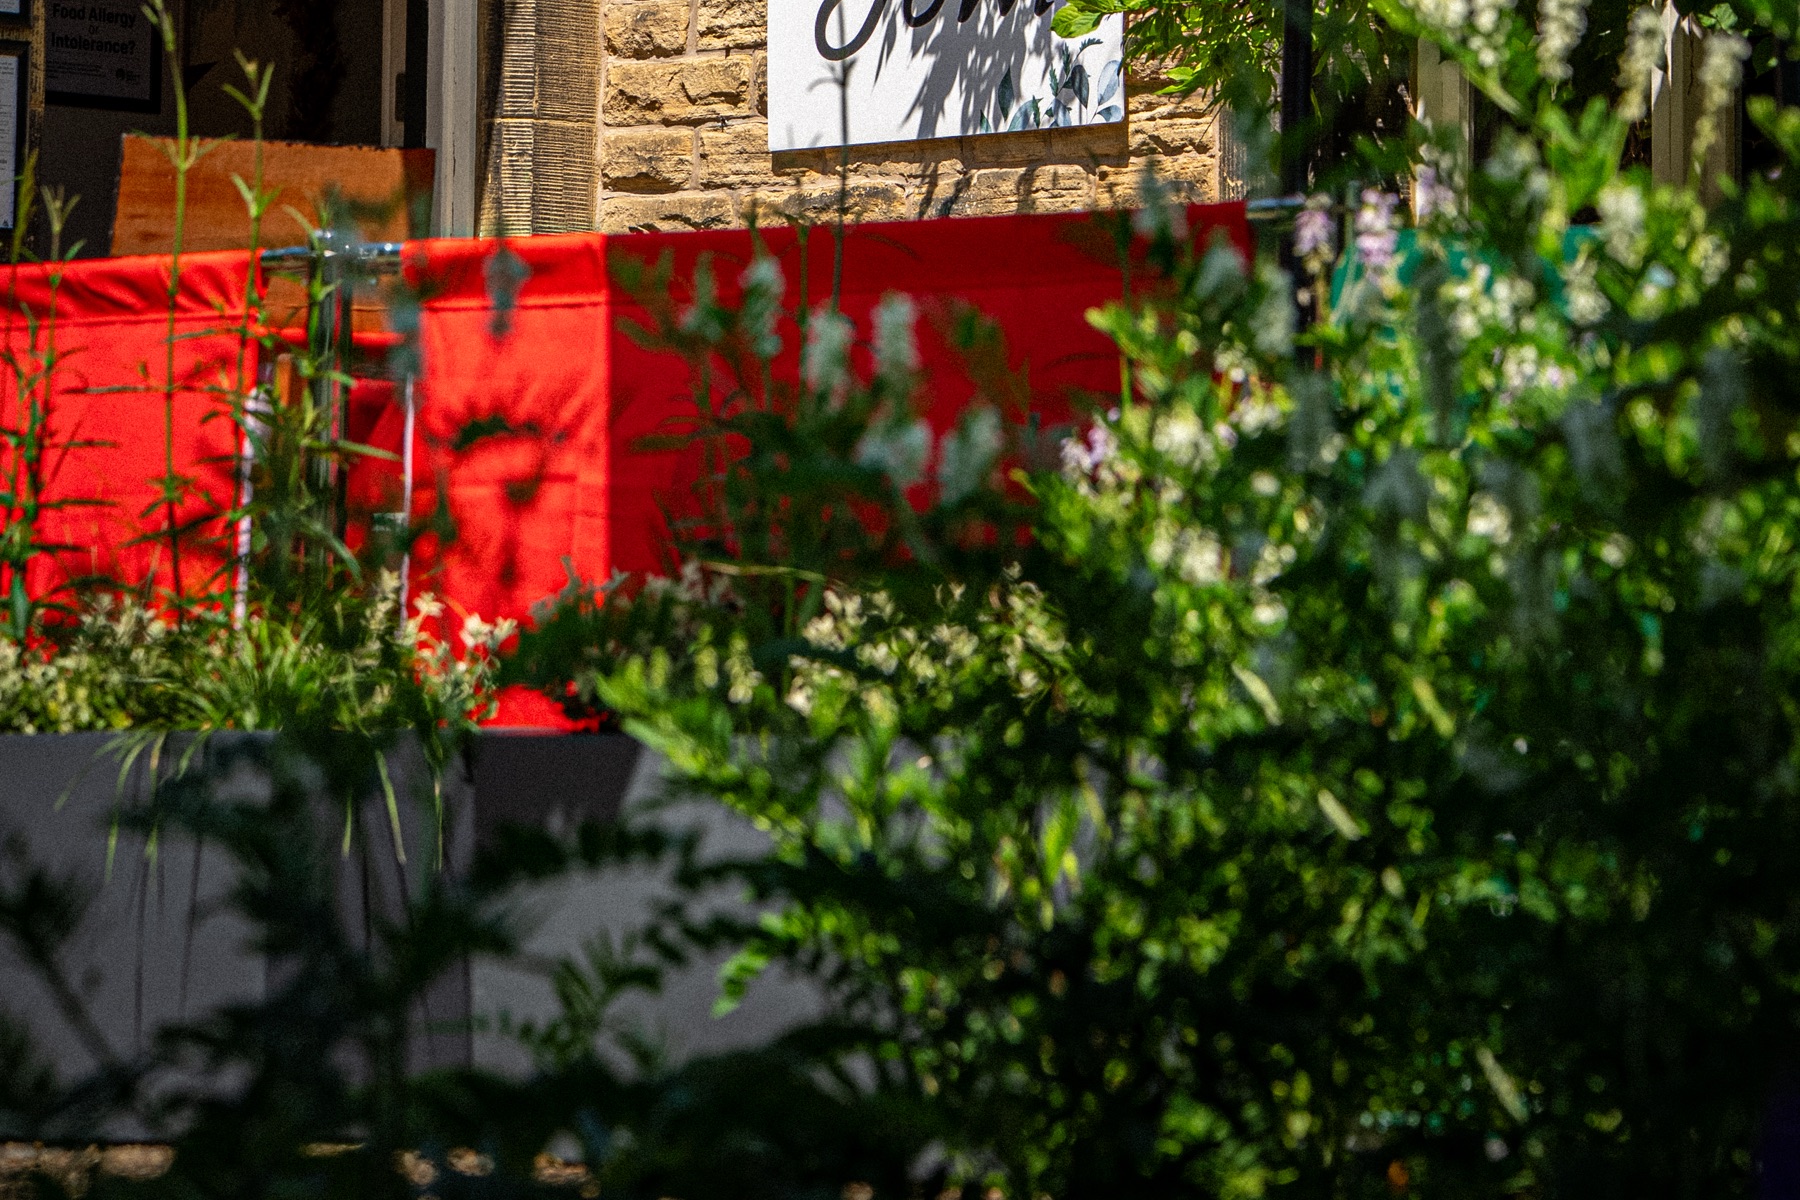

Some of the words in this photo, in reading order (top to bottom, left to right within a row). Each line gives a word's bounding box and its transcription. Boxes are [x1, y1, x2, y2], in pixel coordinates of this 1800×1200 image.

[52, 3, 86, 20] Food
[88, 7, 136, 27] Allergy
[51, 32, 136, 55] Intolerance?
